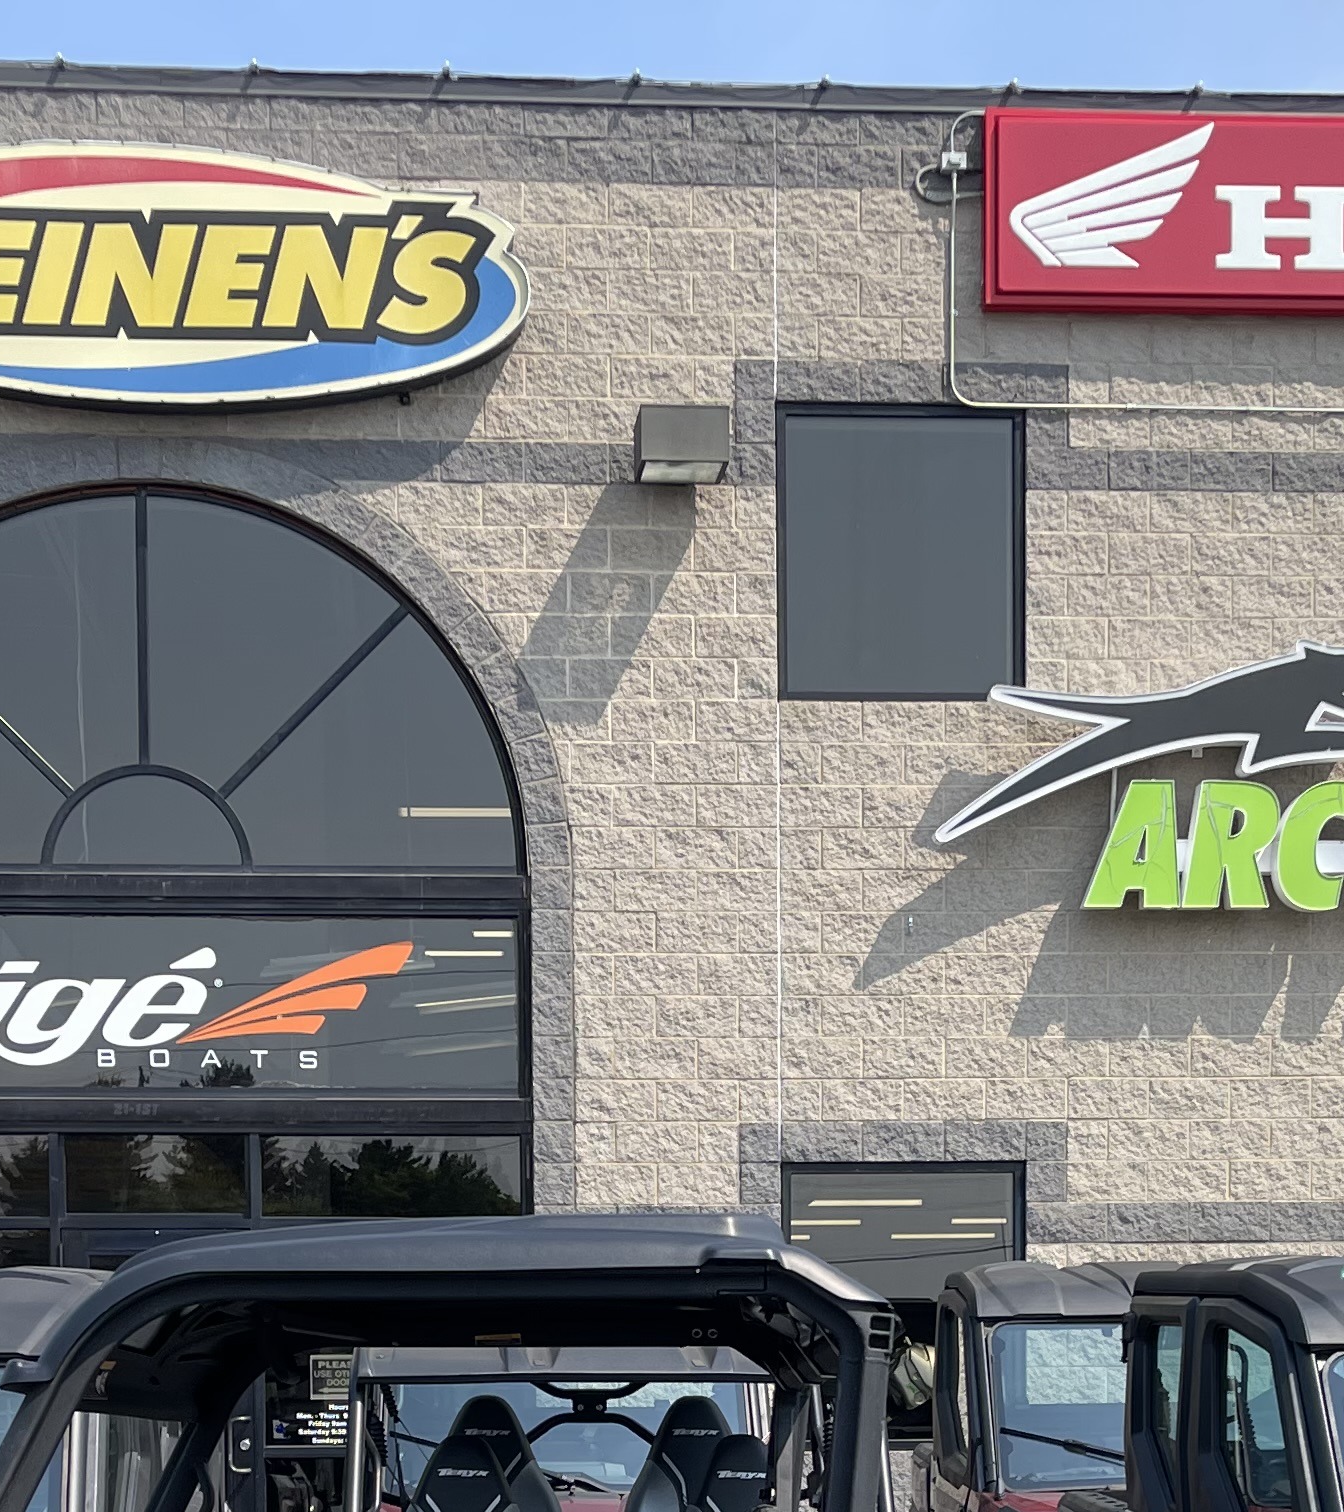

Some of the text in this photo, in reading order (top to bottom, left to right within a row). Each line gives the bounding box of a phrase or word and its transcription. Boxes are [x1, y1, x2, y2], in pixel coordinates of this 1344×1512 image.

[97, 1048, 319, 1069] BOATS
[317, 1360, 351, 1369] PLEAS
[313, 1369, 333, 1378] USE
[326, 1378, 349, 1387] DOO
